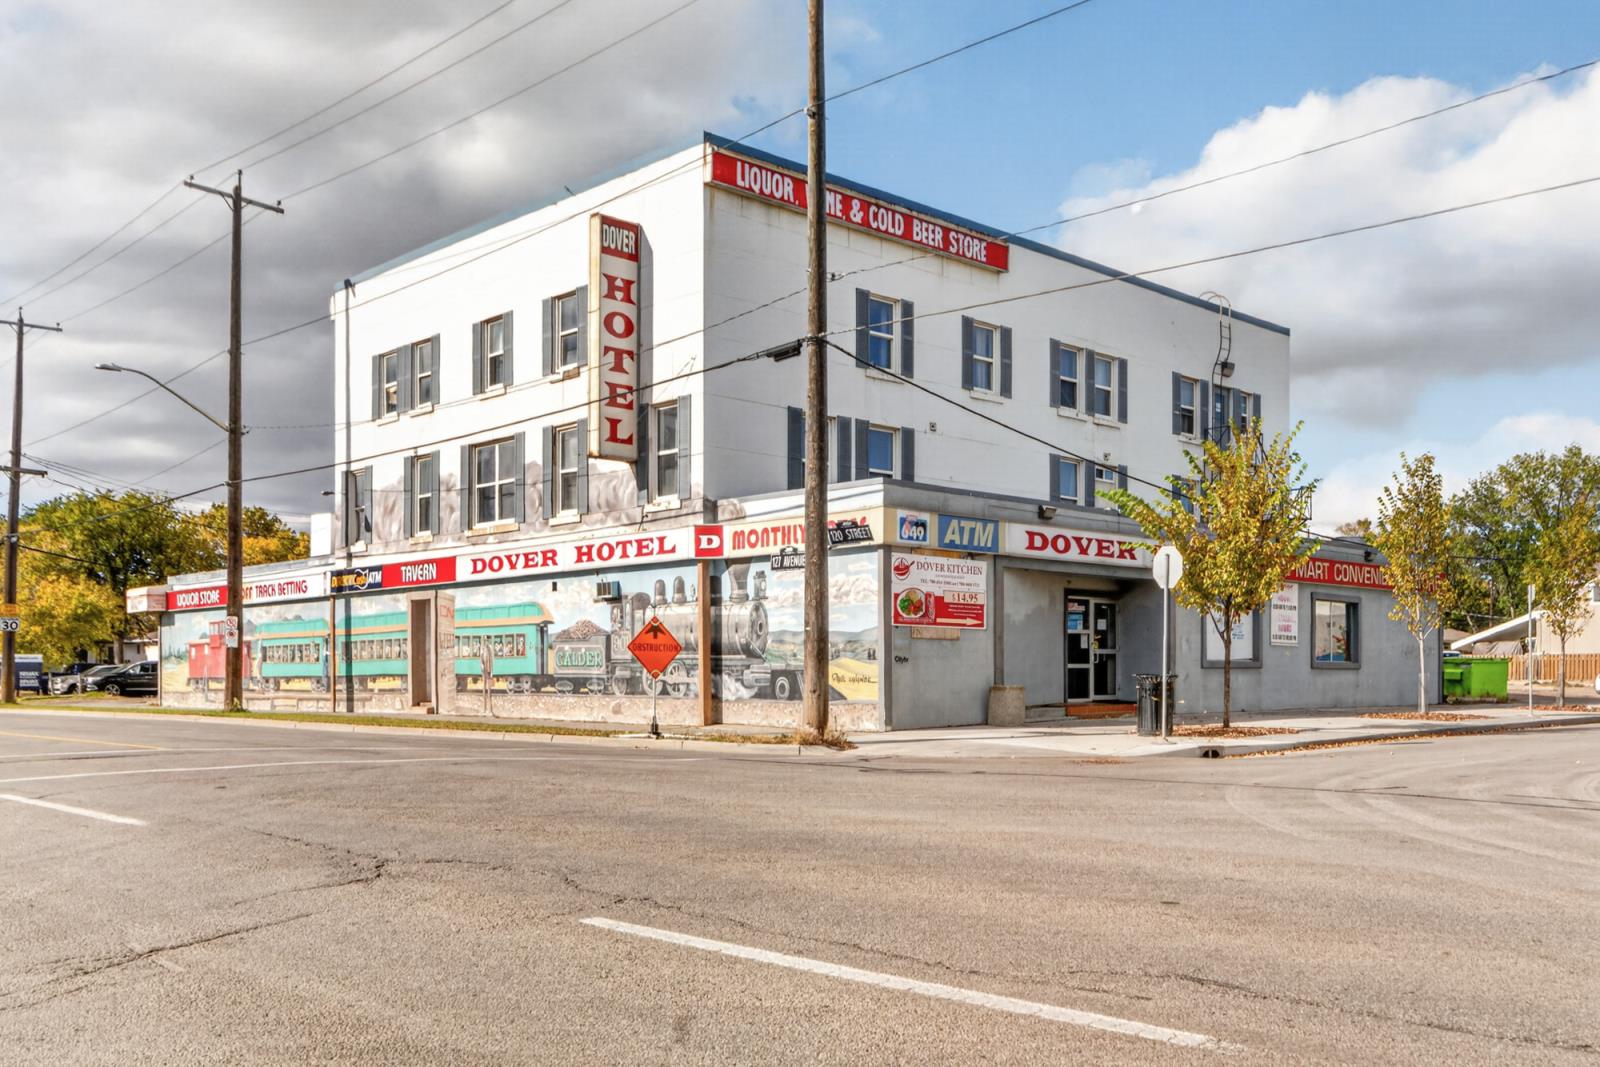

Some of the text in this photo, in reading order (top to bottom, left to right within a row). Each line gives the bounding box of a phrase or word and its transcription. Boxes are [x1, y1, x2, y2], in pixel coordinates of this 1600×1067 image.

[602, 224, 636, 254] DOVER
[850, 199, 864, 225] &
[868, 205, 904, 236] COLD
[912, 220, 944, 249] BEER
[949, 232, 987, 263] STORE
[602, 272, 637, 446] HOTEL
[699, 535, 721, 549] D
[830, 527, 871, 542] 120 STREET
[943, 519, 995, 548] ATM
[1025, 530, 1137, 561] DOVER
[471, 536, 676, 575] DOVER HOTEL
[783, 554, 806, 567] AVENUE
[368, 570, 382, 584] ATM
[401, 562, 437, 583] TAVERN
[916, 560, 983, 576] DOVER KITCHEN
[1295, 561, 1330, 581] MART
[176, 589, 220, 608] LIQUOR STORE
[255, 582, 277, 598] TRACK
[277, 580, 308, 596] BETTING
[2, 621, 18, 630] 30
[632, 643, 679, 652] OBSTRUCTION
